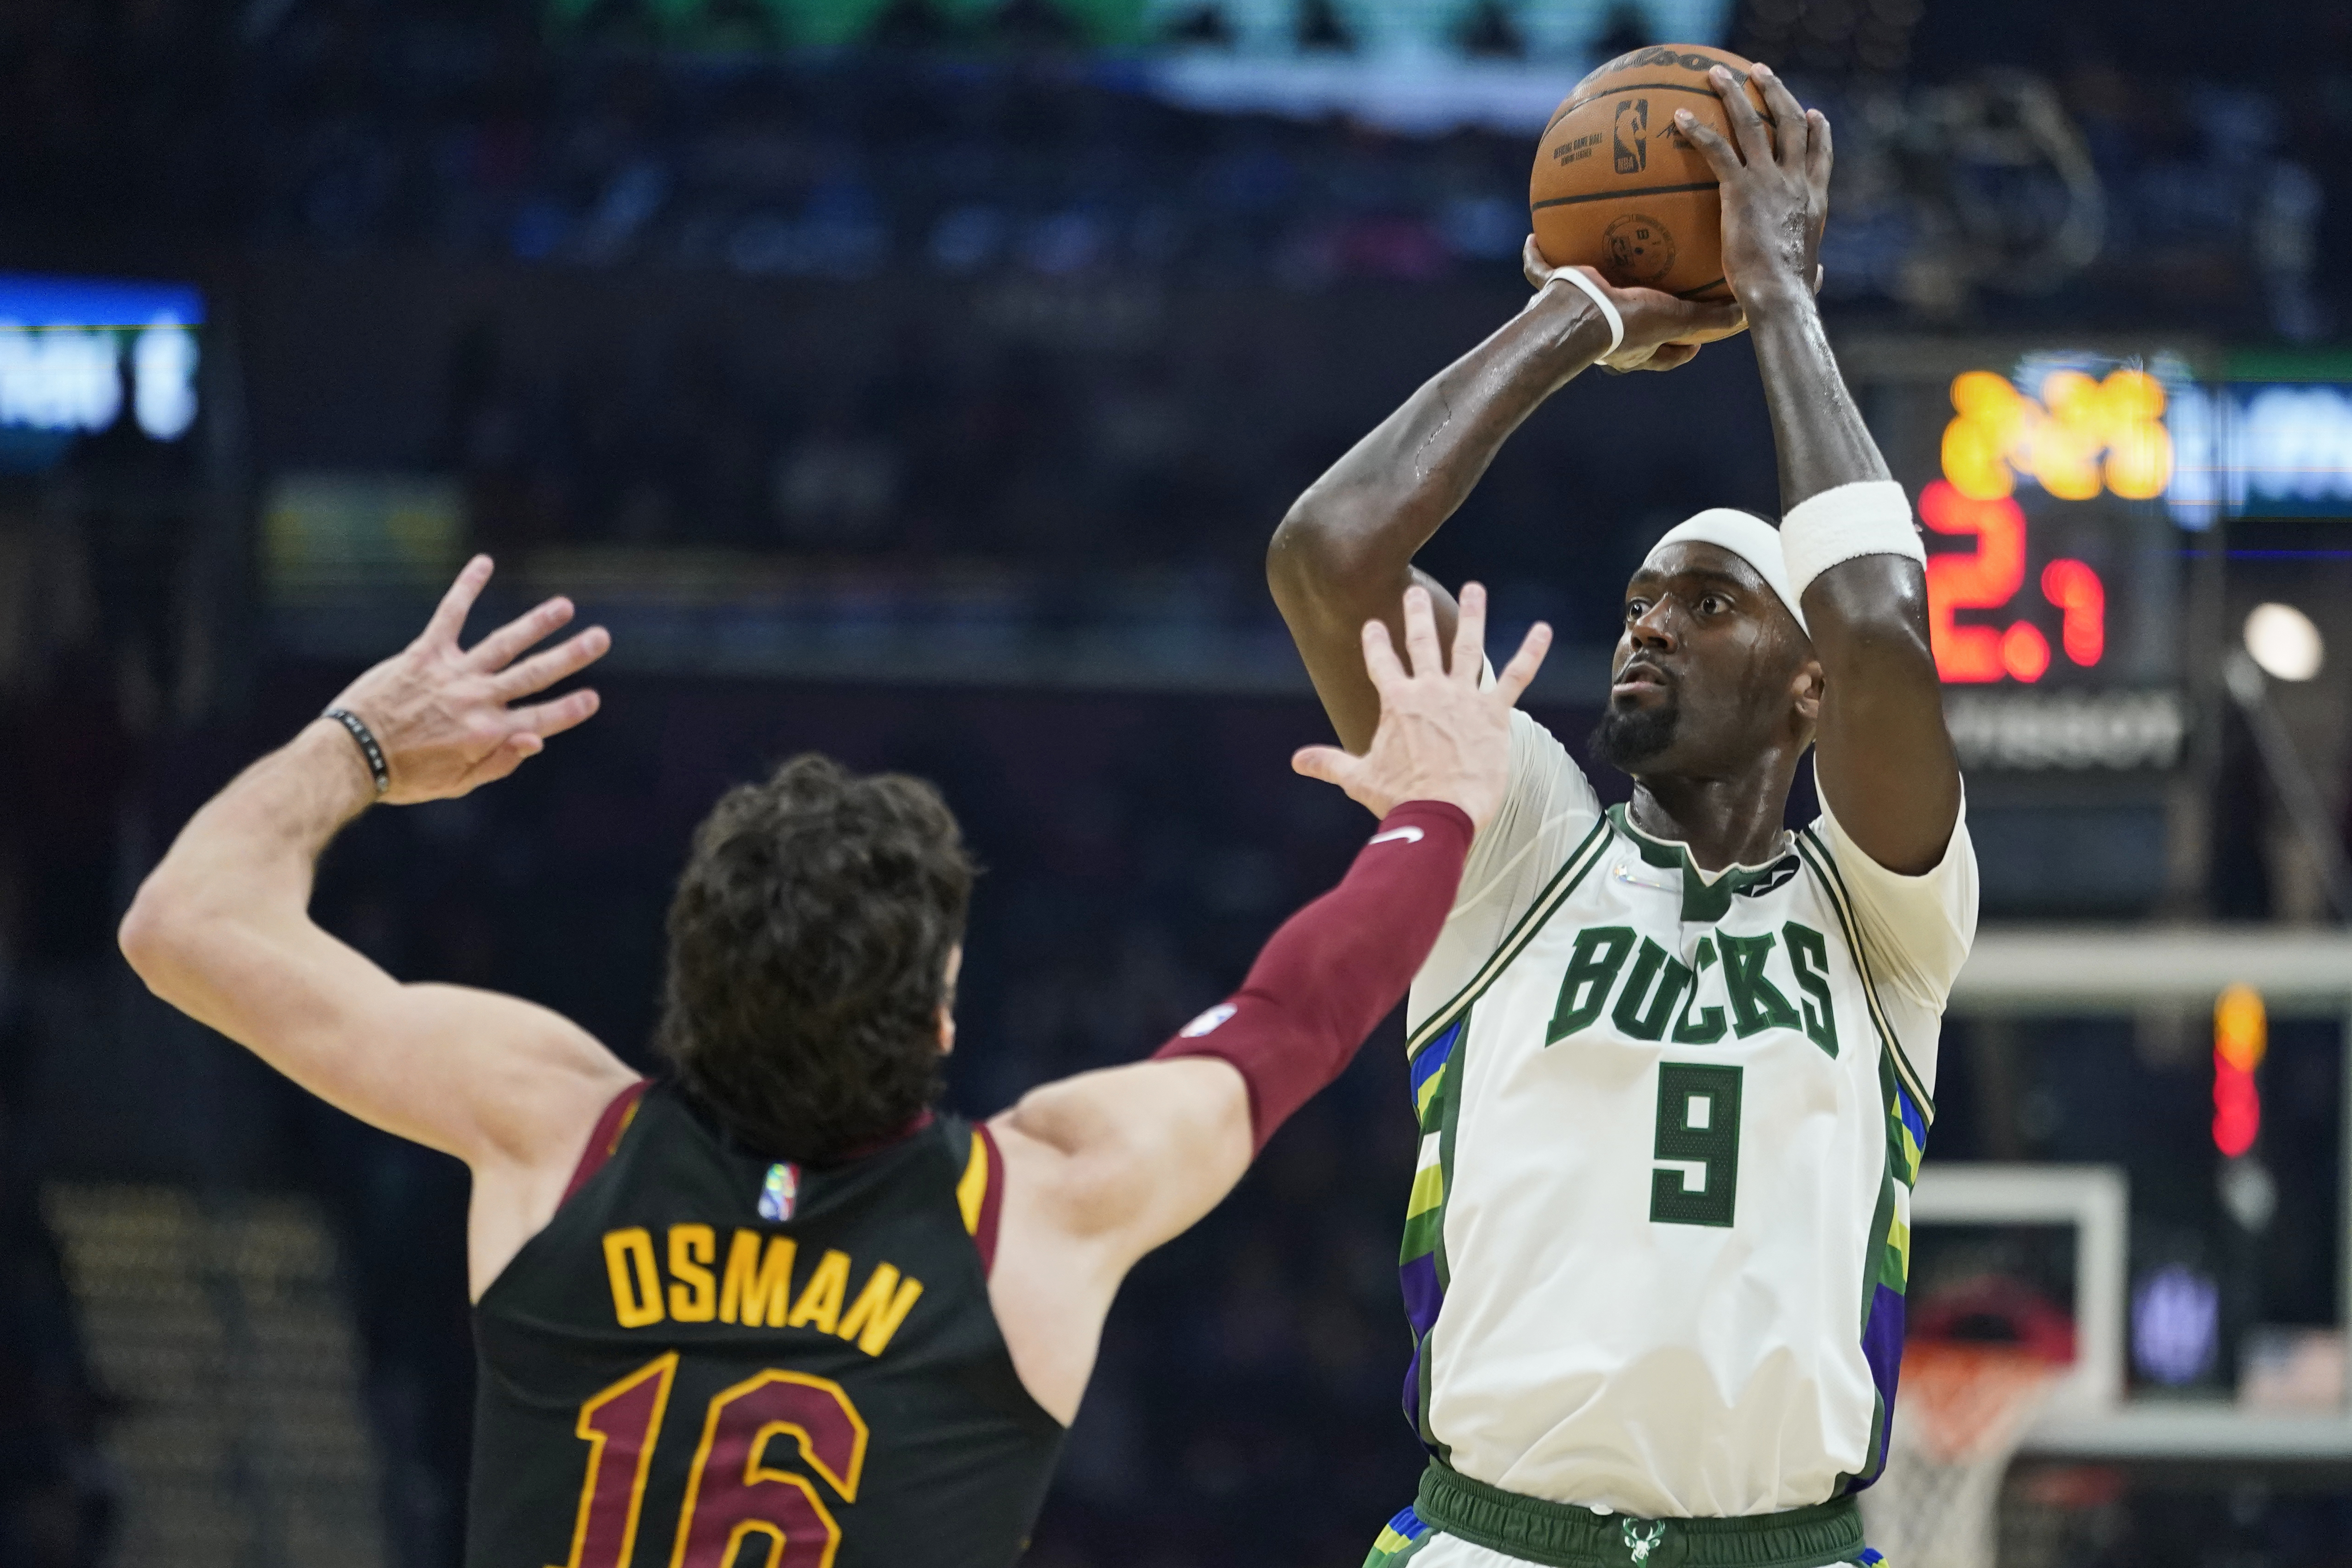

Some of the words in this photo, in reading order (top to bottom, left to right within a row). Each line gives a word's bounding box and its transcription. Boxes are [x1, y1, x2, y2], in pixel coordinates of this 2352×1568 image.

[1617, 156, 1634, 171] NBA
[1545, 921, 1839, 1060] BUCKS
[1649, 1061, 1743, 1227] 9
[602, 1223, 923, 1357] OSMAN
[543, 1349, 869, 1568] 16
